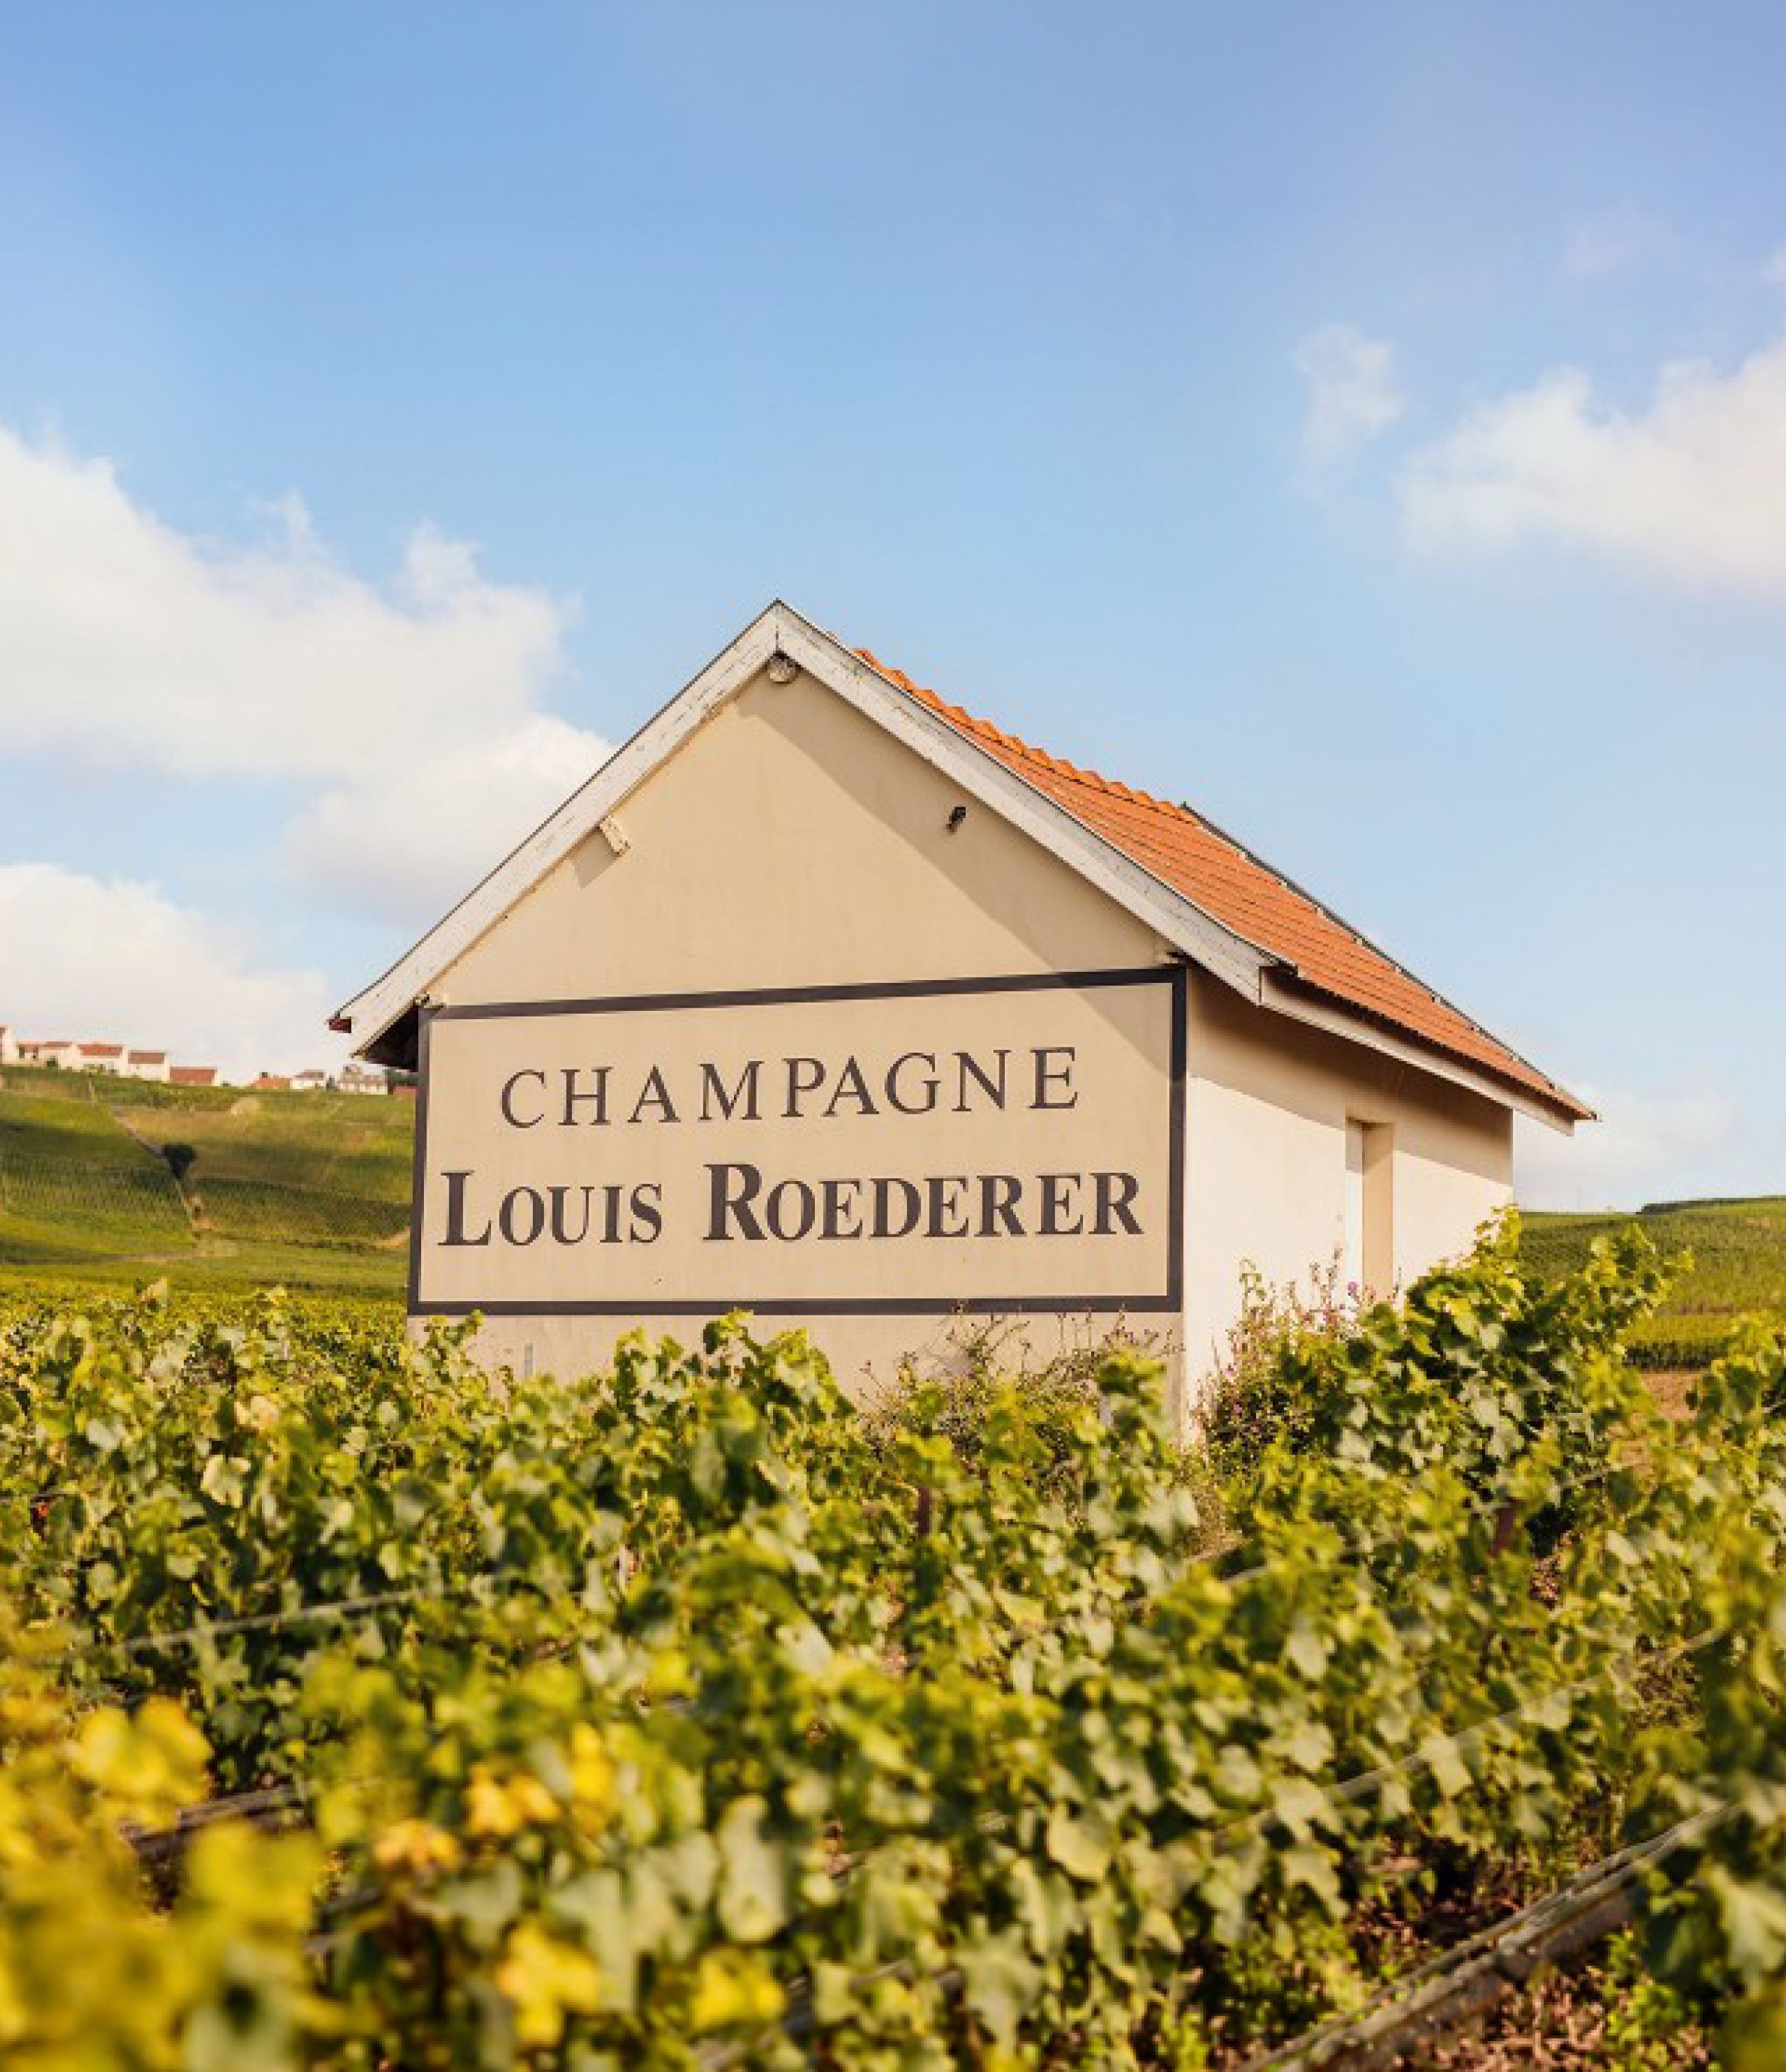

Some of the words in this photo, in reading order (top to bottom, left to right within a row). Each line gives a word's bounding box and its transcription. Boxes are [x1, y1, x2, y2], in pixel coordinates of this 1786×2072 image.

[501, 1046, 1080, 1129] CHAMPAGNE
[438, 1169, 663, 1246] LOUIS
[702, 1163, 1144, 1241] ROEDERER
